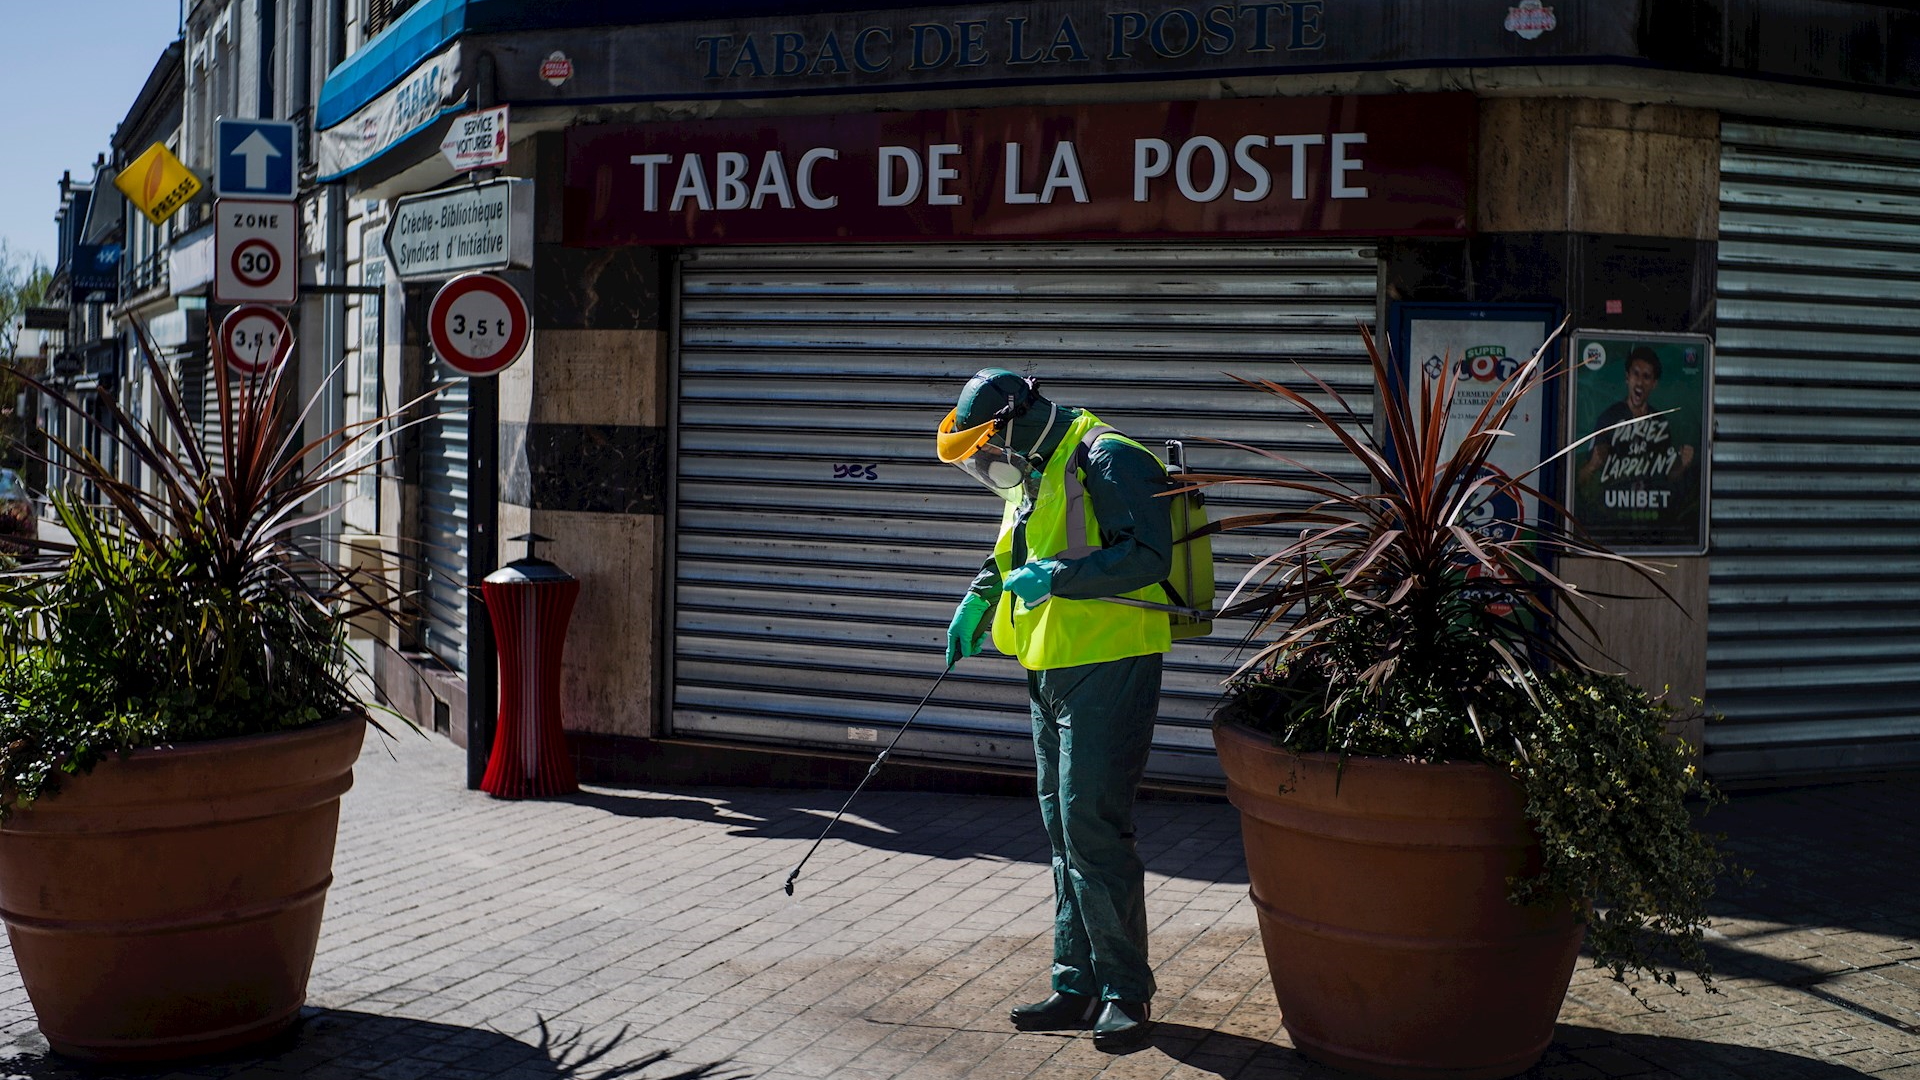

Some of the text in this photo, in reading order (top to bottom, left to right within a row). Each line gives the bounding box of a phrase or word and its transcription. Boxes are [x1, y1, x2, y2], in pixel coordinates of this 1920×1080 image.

[696, 1, 1327, 80] TABAC DE LA POSTE
[395, 65, 440, 125] TABAC
[463, 116, 493, 137] SERVICE
[456, 133, 493, 154] VOITURIER
[630, 132, 1369, 212] TABAC DE LA POSTE
[151, 177, 195, 219] PRESSE
[233, 213, 278, 229] ZONE
[400, 230, 503, 269] Syndicat d'Initiative
[241, 252, 271, 274] 30
[453, 314, 505, 339] 3,5 t
[235, 330, 277, 349] 3,5 t
[1467, 346, 1504, 358] SUPER
[1611, 418, 1669, 447] PARIEZ
[1628, 441, 1648, 455] SUR
[833, 463, 878, 480] yes
[1604, 489, 1671, 508] UNIBET
